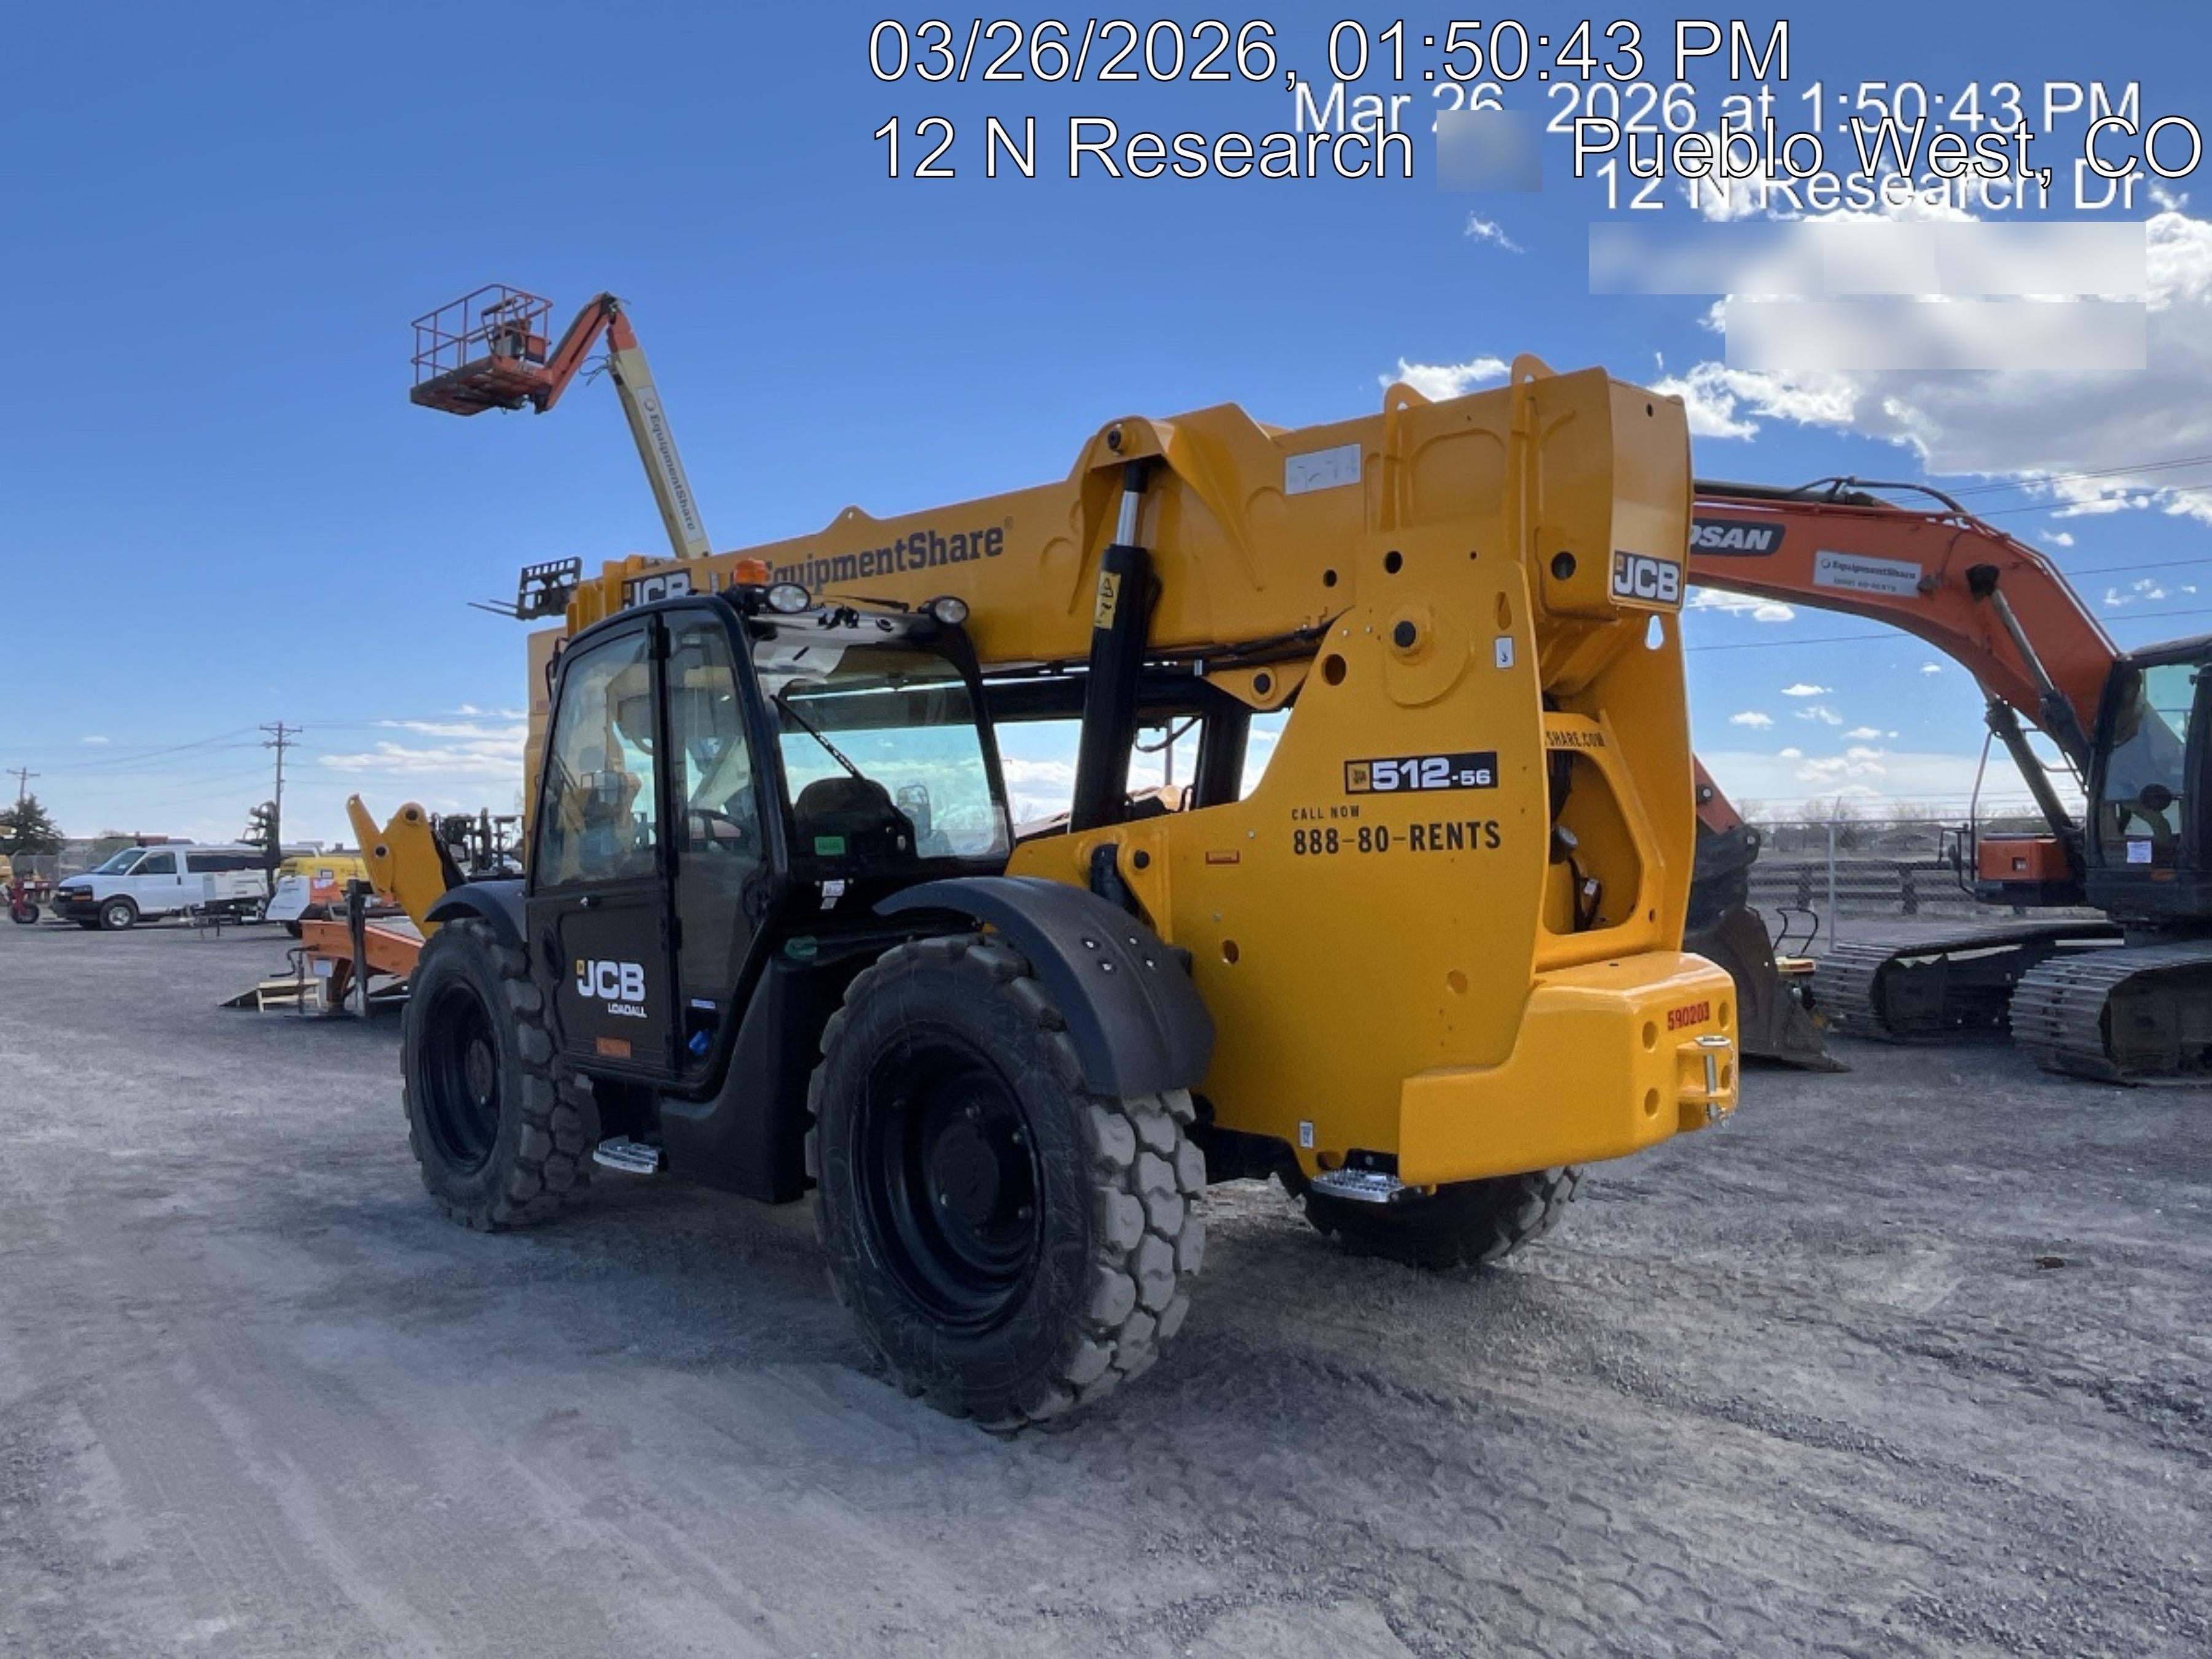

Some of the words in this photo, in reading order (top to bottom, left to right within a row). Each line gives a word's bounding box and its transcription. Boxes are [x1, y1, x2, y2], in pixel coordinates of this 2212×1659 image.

[1614, 555, 1679, 602] JCB
[1372, 757, 1491, 790] 512-56
[1292, 807, 1324, 821] CALL
[1330, 805, 1360, 818] NOW
[1293, 820, 1501, 855] 888-80-RENTS
[576, 960, 646, 1002] JCB
[608, 1002, 648, 1018] LOADALL
